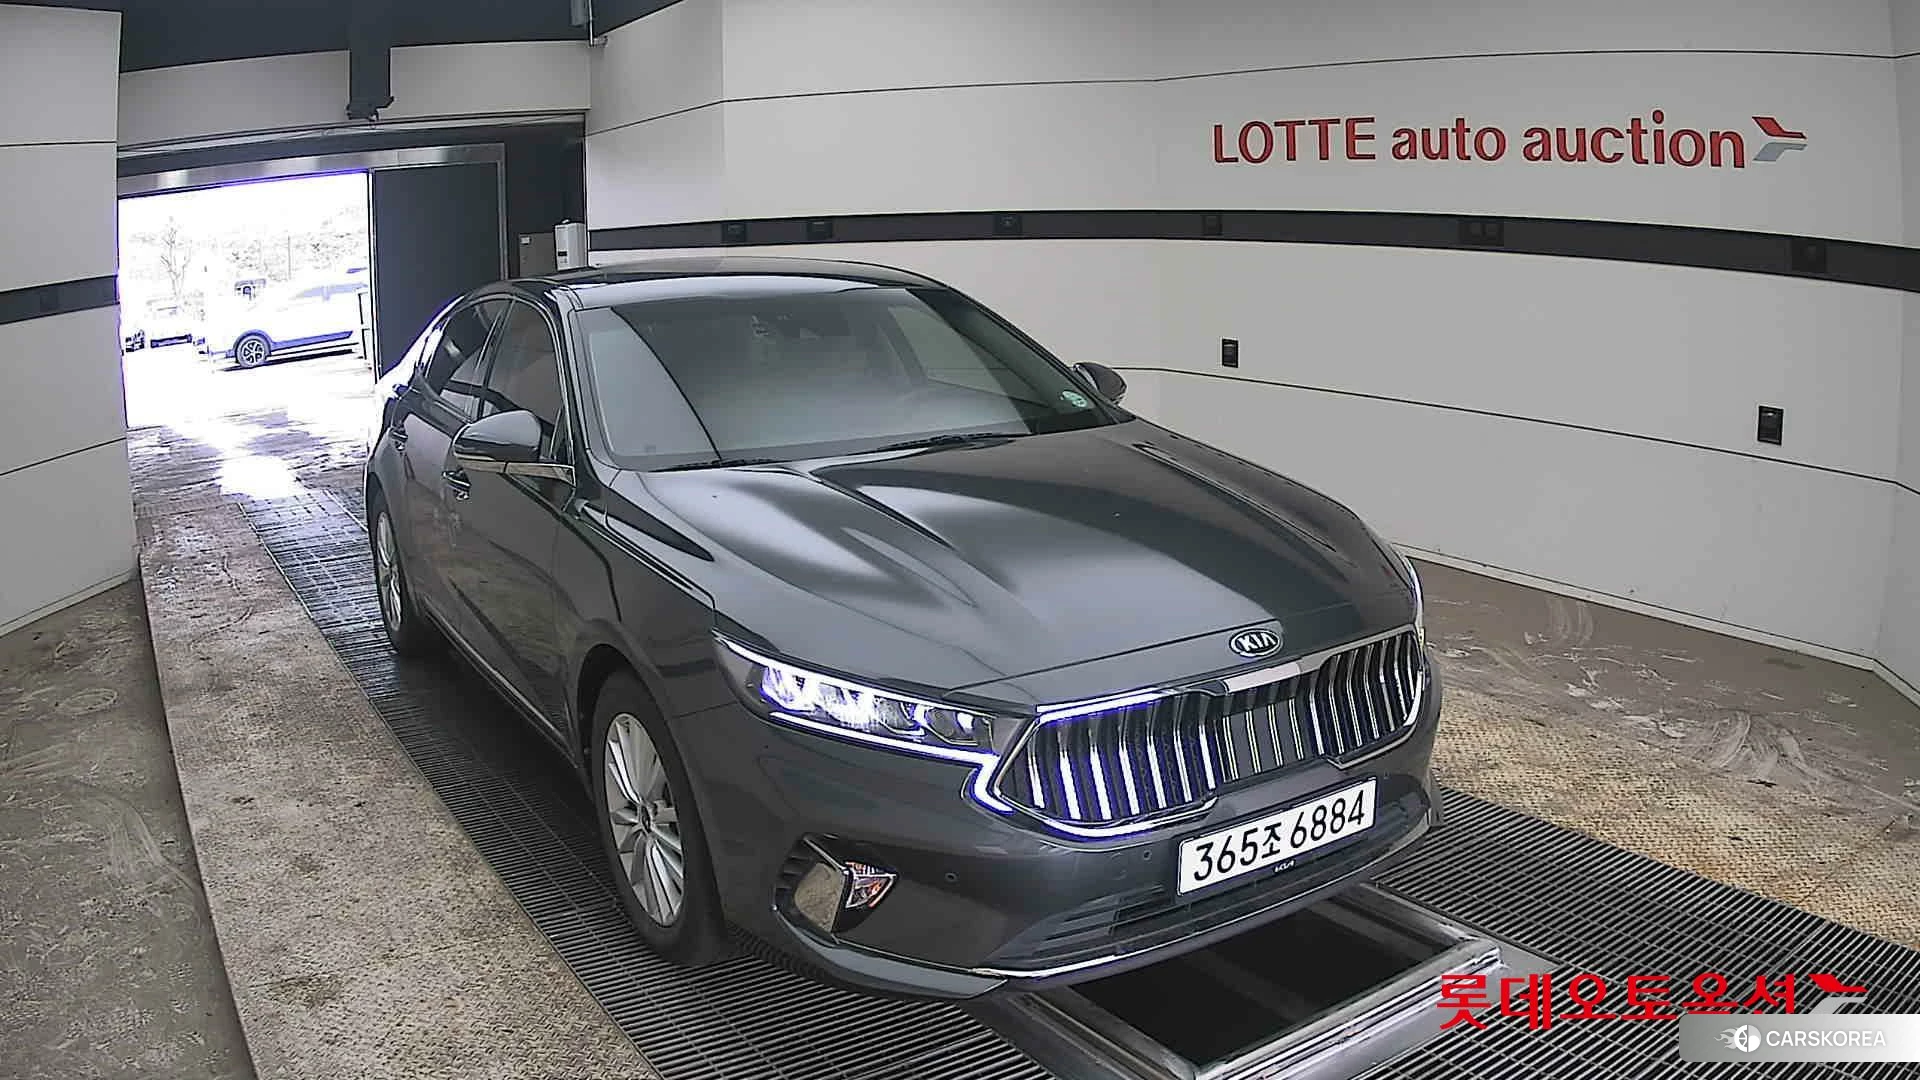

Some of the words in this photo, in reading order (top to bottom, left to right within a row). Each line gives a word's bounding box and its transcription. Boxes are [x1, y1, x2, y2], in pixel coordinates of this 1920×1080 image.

[1213, 118, 1376, 164] LOTTE
[1391, 117, 1507, 162] auto
[1521, 109, 1746, 169] auction
[1238, 632, 1277, 652] KIA
